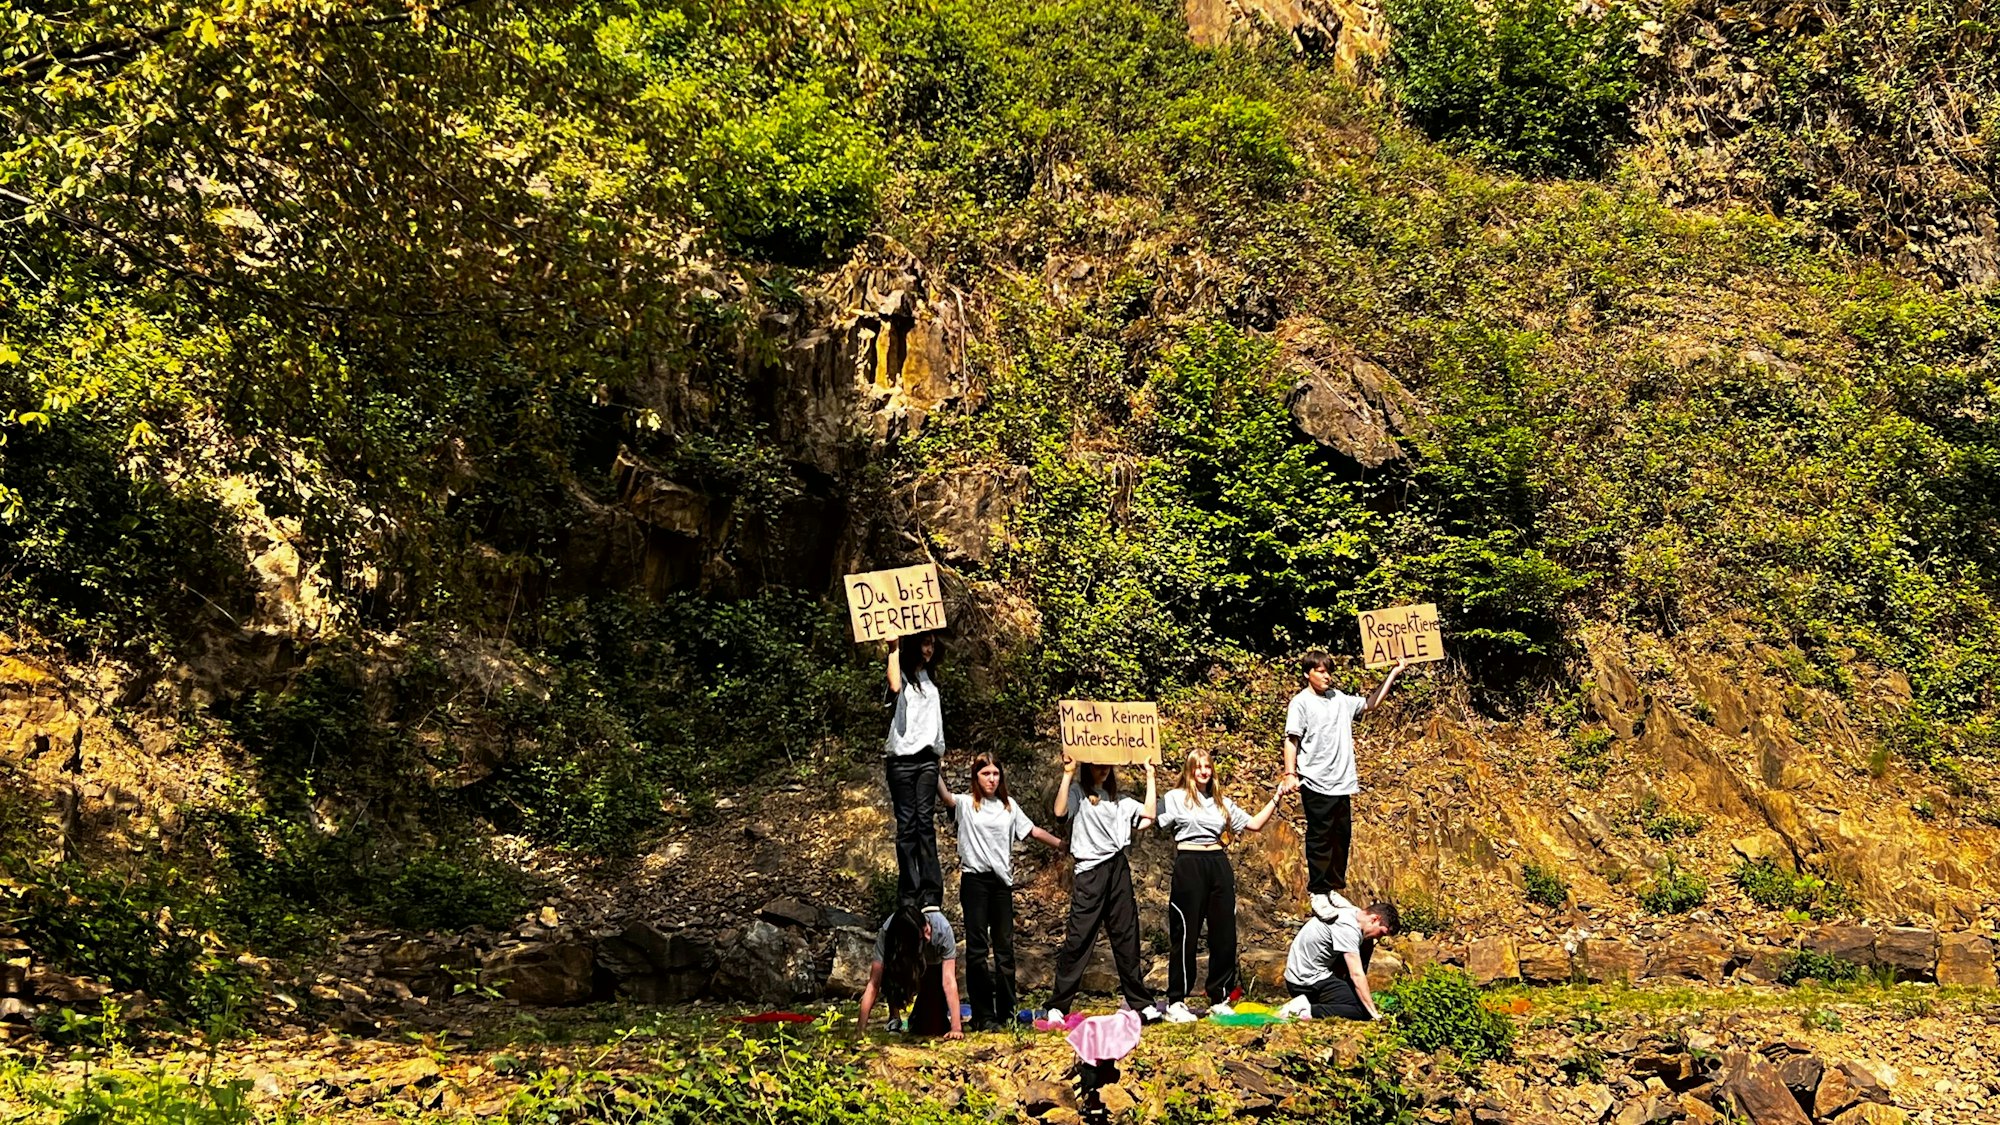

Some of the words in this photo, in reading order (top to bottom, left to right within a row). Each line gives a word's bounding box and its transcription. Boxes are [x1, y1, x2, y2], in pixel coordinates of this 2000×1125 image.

[853, 582, 889, 610] Du
[895, 572, 934, 601] bist
[859, 601, 942, 638] PERFEKT
[1362, 610, 1440, 647] Respektiere
[1371, 635, 1429, 663] ALLE
[1061, 705, 1102, 723] Mach
